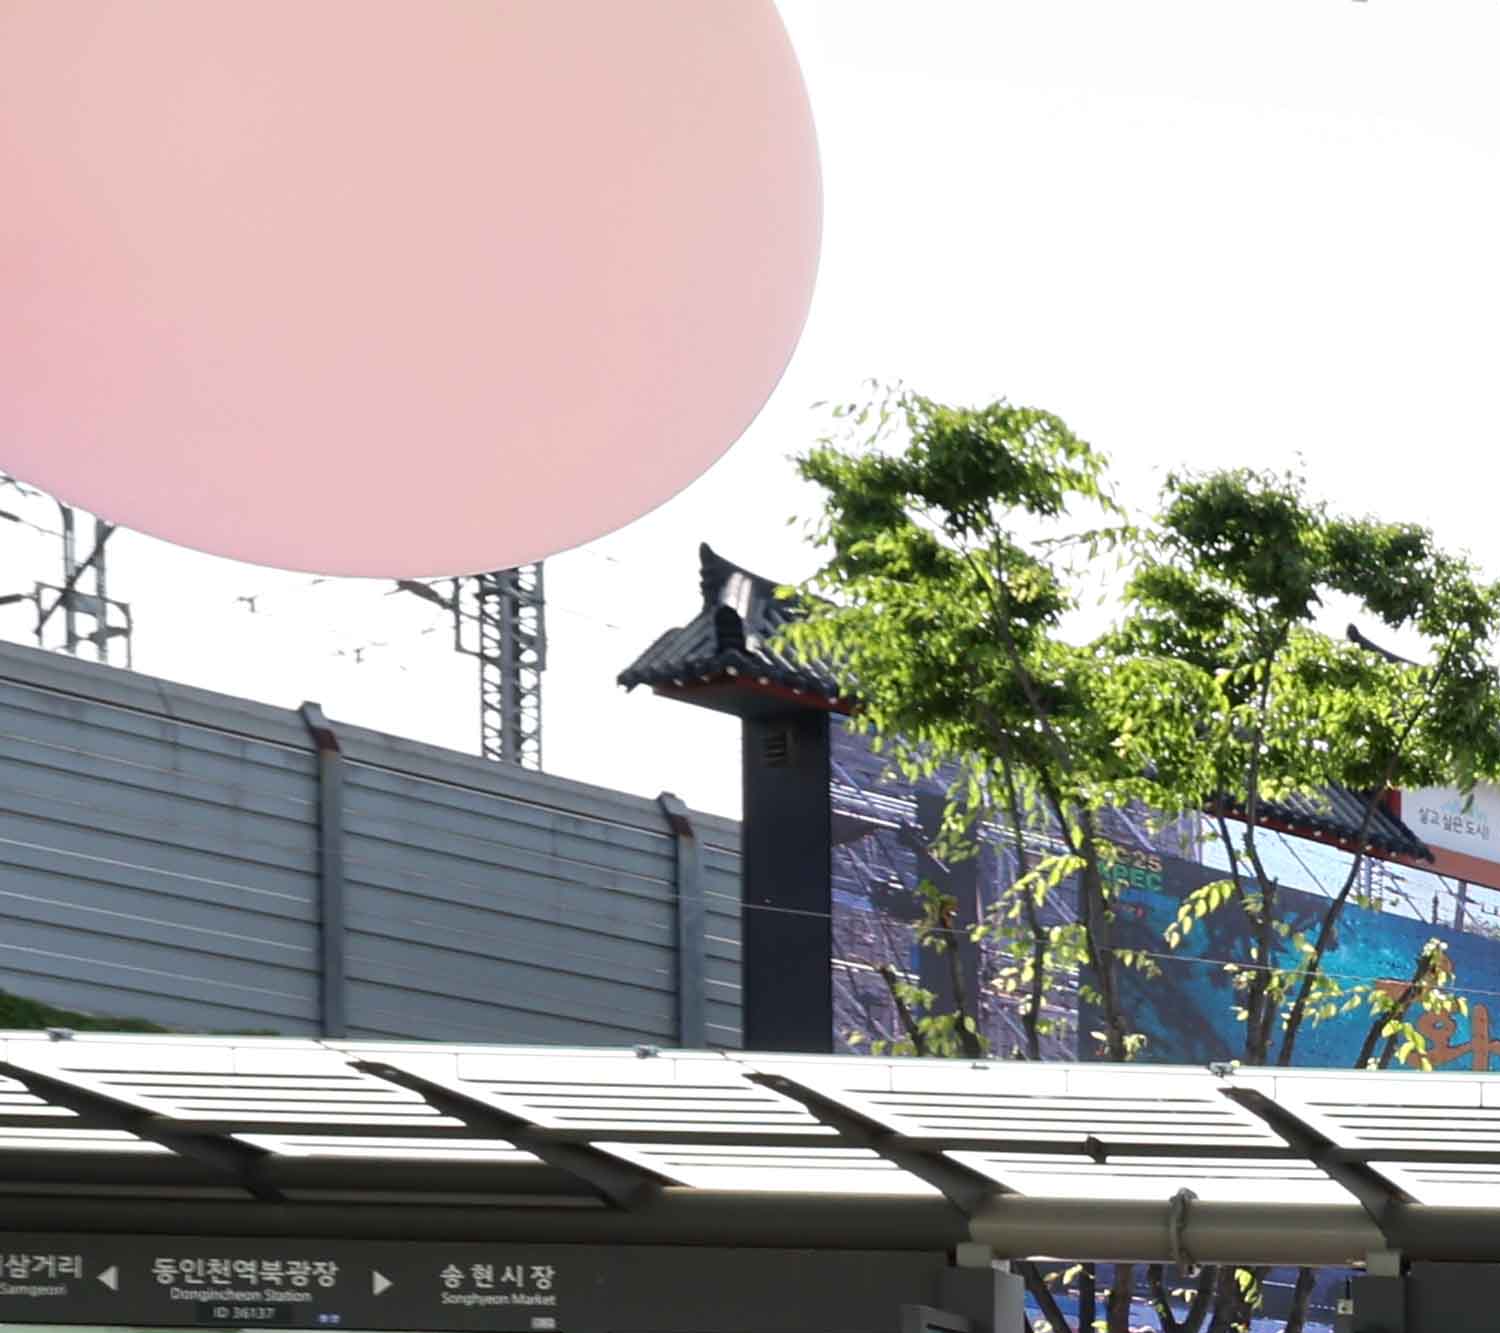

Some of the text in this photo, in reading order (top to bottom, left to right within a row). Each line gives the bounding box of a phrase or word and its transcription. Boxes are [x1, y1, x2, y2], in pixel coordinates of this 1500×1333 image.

[0, 1253, 556, 1290] 삼거리 동인천역북광장 송현시장
[264, 1288, 312, 1303] Station
[512, 1293, 557, 1306] Market
